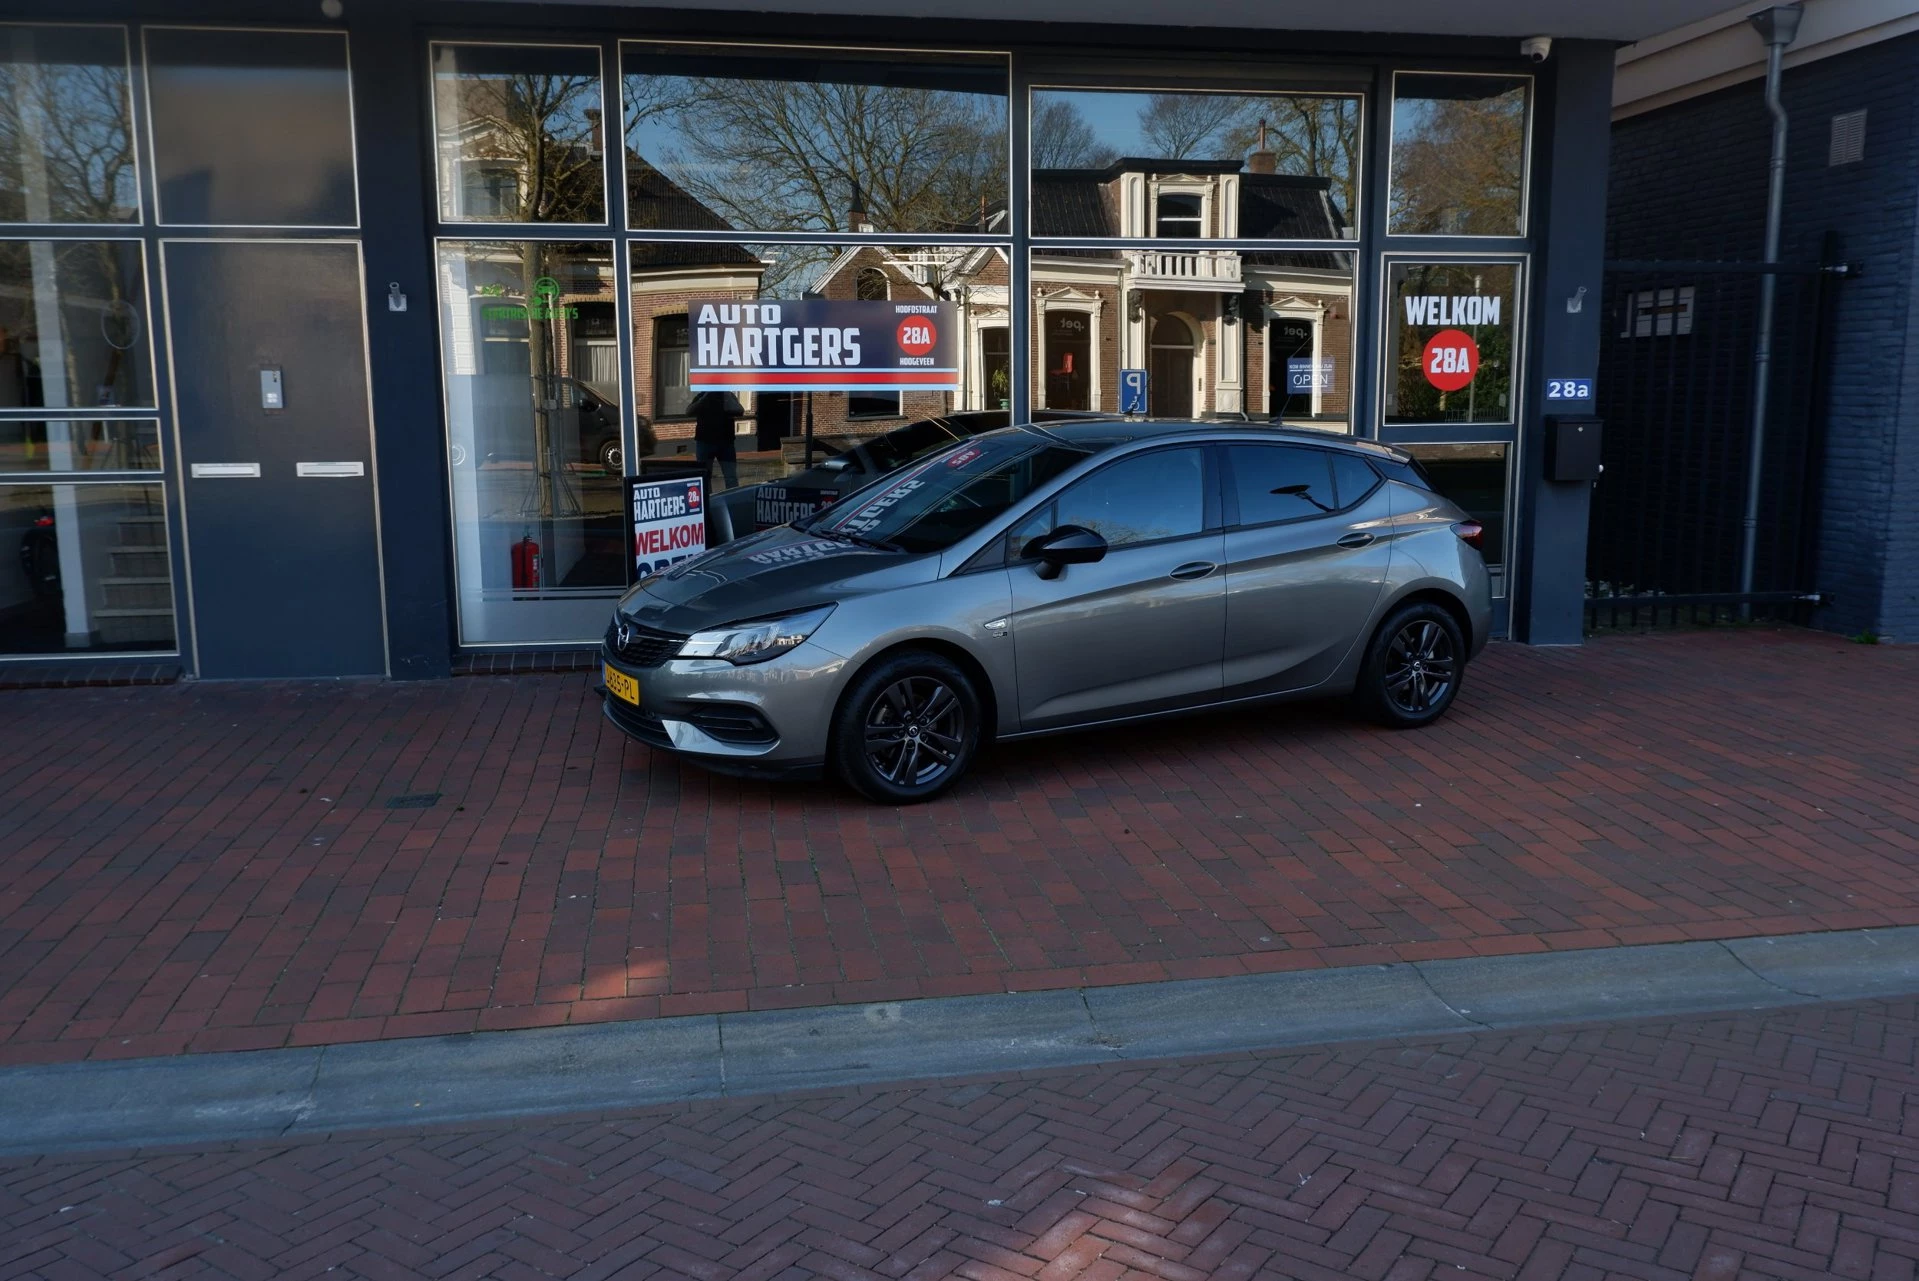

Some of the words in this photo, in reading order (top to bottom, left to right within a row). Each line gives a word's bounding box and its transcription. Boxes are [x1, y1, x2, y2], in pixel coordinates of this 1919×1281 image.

[697, 304, 781, 325] AUTO
[895, 305, 937, 314] HOOFDSTRAAT
[1405, 296, 1500, 325] WELKOM
[902, 327, 931, 345] 28A
[697, 327, 861, 366] HARTGERS
[900, 357, 935, 366] HOOGEVEEN
[1430, 347, 1470, 373] 28A
[1548, 380, 1590, 398] 28a
[633, 487, 660, 501] AUTO
[757, 487, 787, 500] AUTO
[633, 496, 686, 522] HARTGERS
[635, 523, 705, 557] WELKOM
